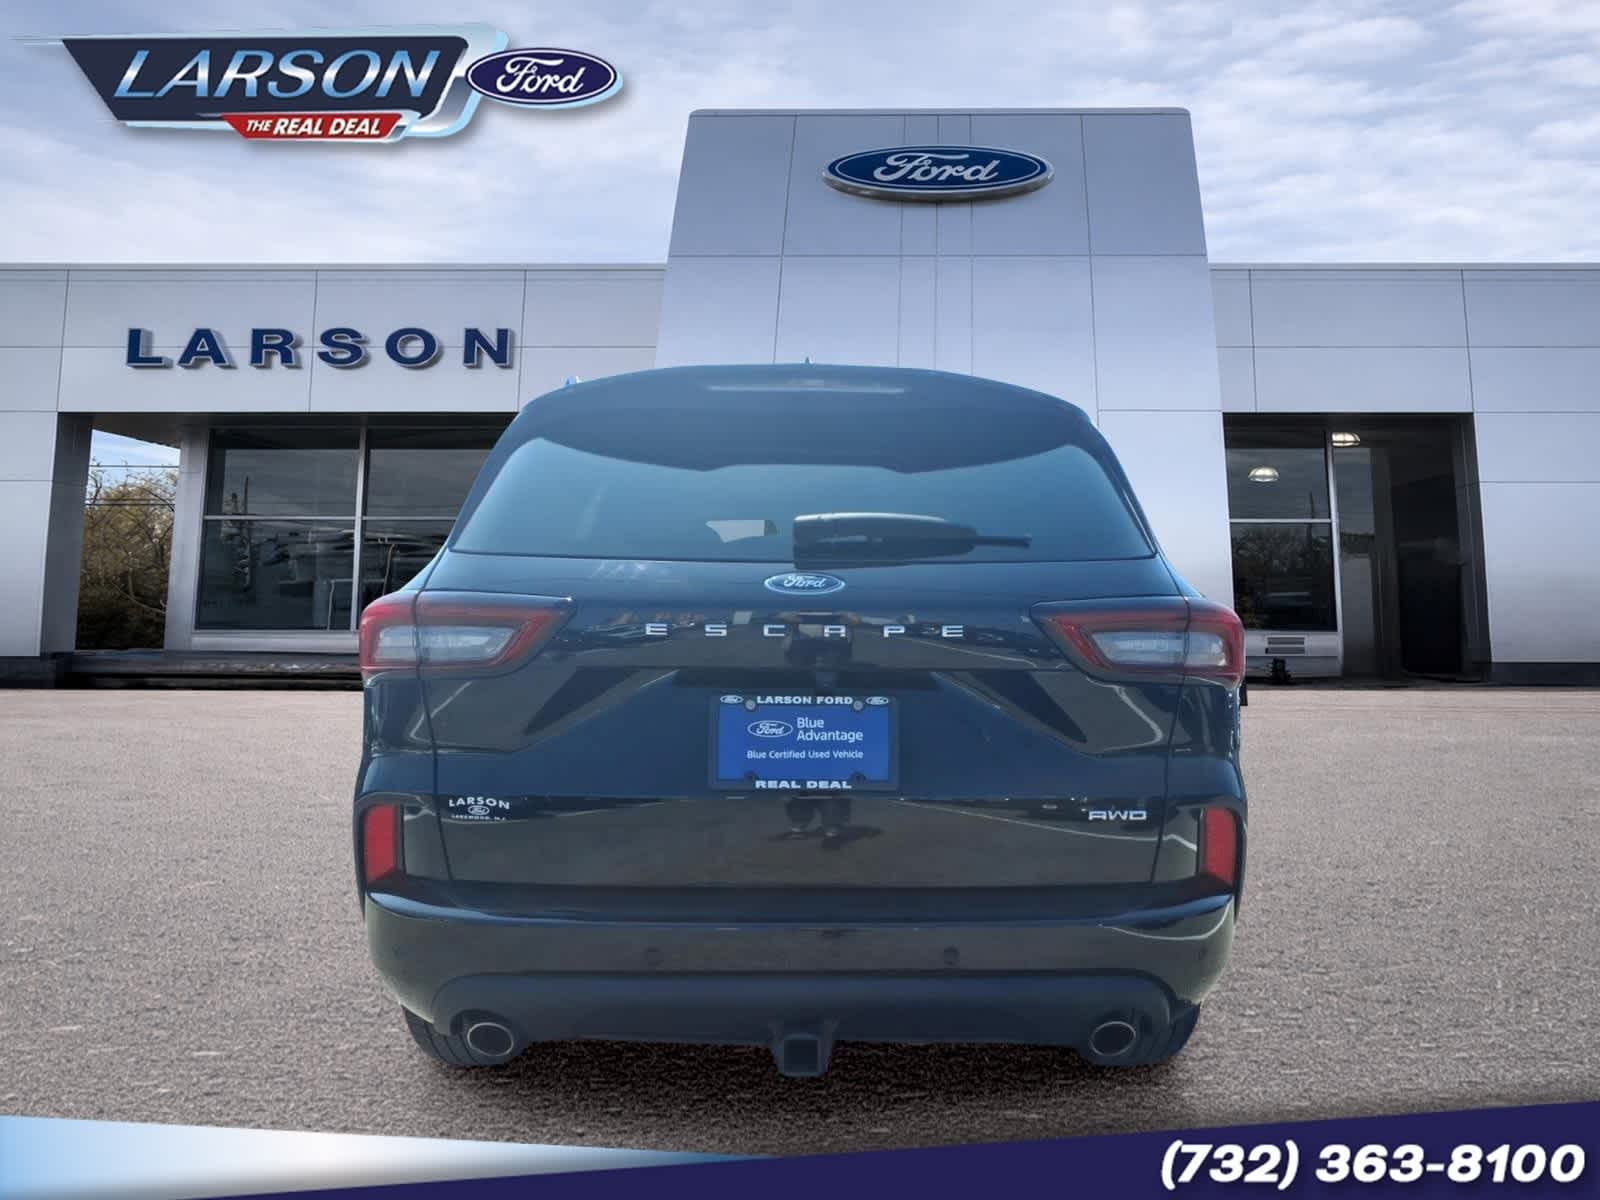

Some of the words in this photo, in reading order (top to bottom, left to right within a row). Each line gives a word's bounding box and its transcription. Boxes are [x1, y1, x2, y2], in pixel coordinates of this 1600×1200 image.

[873, 152, 1000, 181] Ford
[125, 327, 516, 369] LARSON
[783, 574, 827, 590] Ford
[645, 623, 964, 638] ESCAPE
[756, 695, 812, 705] LARSON
[816, 695, 854, 705] FORD
[756, 722, 785, 736] Ford
[796, 717, 825, 728] Blue
[796, 729, 864, 743] Advantage
[747, 750, 766, 759] Blue
[769, 750, 806, 759] Certified
[808, 750, 830, 759] Used
[833, 750, 864, 759] Vehicle
[755, 780, 801, 789] REAL
[806, 780, 853, 789] DEAL
[448, 796, 511, 810] LARSON
[1088, 810, 1147, 821] AWD
